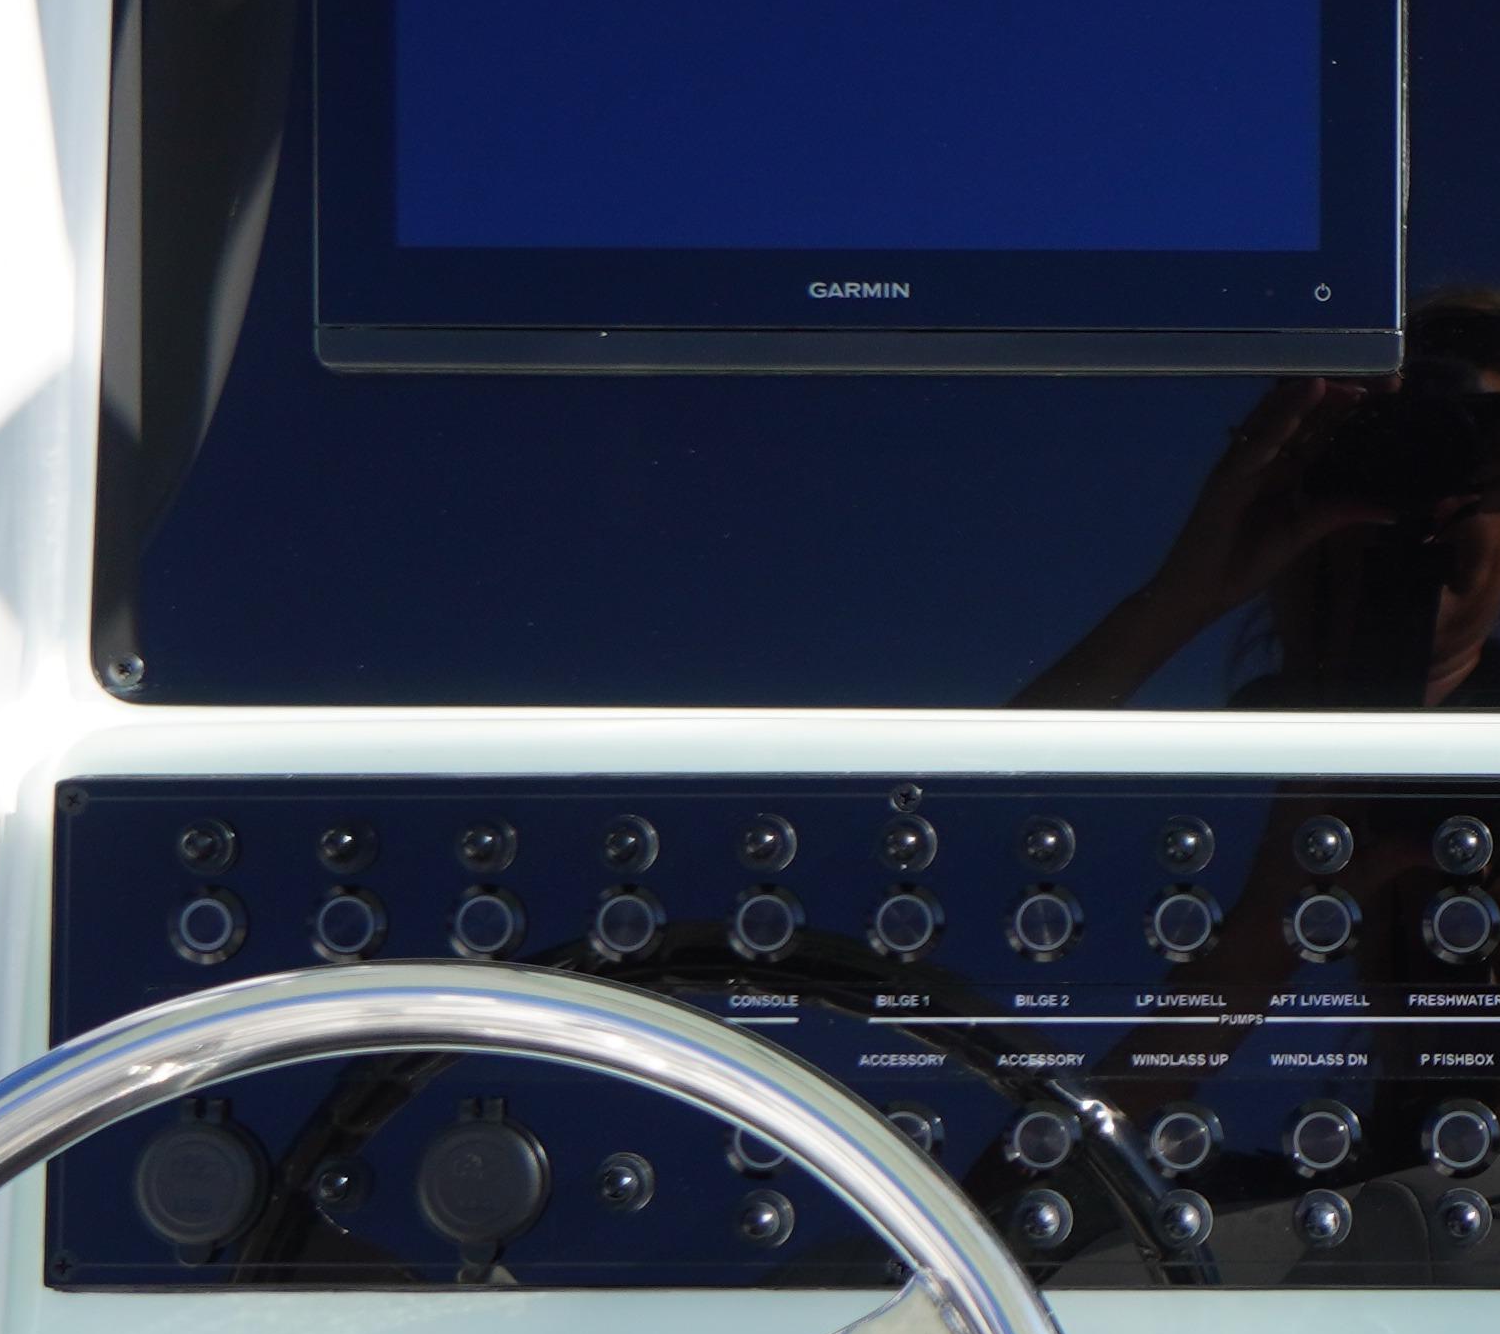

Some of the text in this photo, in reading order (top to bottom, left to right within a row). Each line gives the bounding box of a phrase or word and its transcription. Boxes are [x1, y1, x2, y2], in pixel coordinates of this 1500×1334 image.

[808, 281, 911, 299] GARMIN
[730, 994, 799, 1008] CONSOLE
[875, 994, 931, 1007] BILGE 1
[1014, 994, 1070, 1007] BILGE 2
[1136, 994, 1228, 1007] LP LIVEWELL
[1269, 993, 1371, 1007] AFT LIVEWELL
[1219, 1014, 1264, 1026] PUMPS
[858, 1053, 948, 1067] ACCESSORY
[997, 1053, 1087, 1067] ACCESSORY
[1132, 1053, 1230, 1067] WINDLASS UP
[1270, 1053, 1368, 1067] WINDLASS DN
[1420, 1053, 1496, 1067] P FISHBOX
